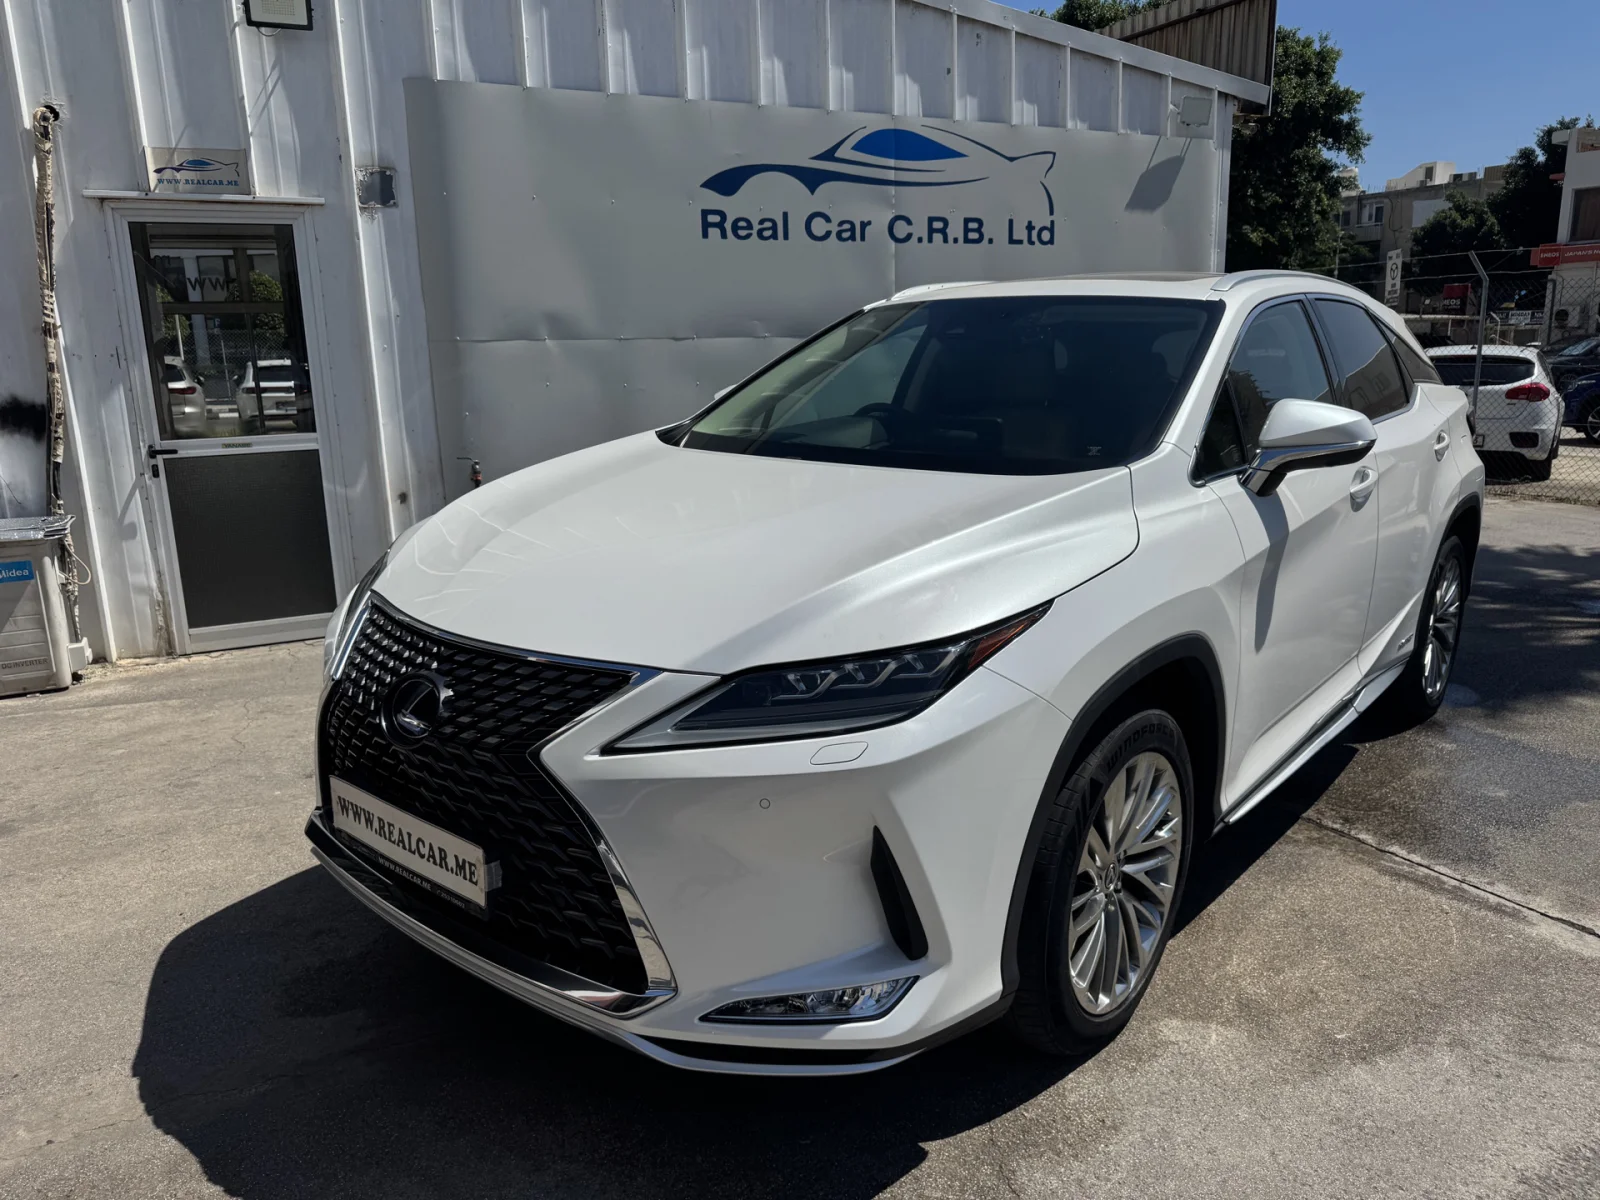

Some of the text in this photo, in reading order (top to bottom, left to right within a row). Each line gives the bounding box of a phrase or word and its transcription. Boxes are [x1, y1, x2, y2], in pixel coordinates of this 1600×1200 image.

[700, 209, 1055, 246] Real Car C.R.B. Ltd
[337, 795, 478, 886] WWW.REALCAR.ME
[379, 857, 432, 891] WWW.REALCAR.ME
